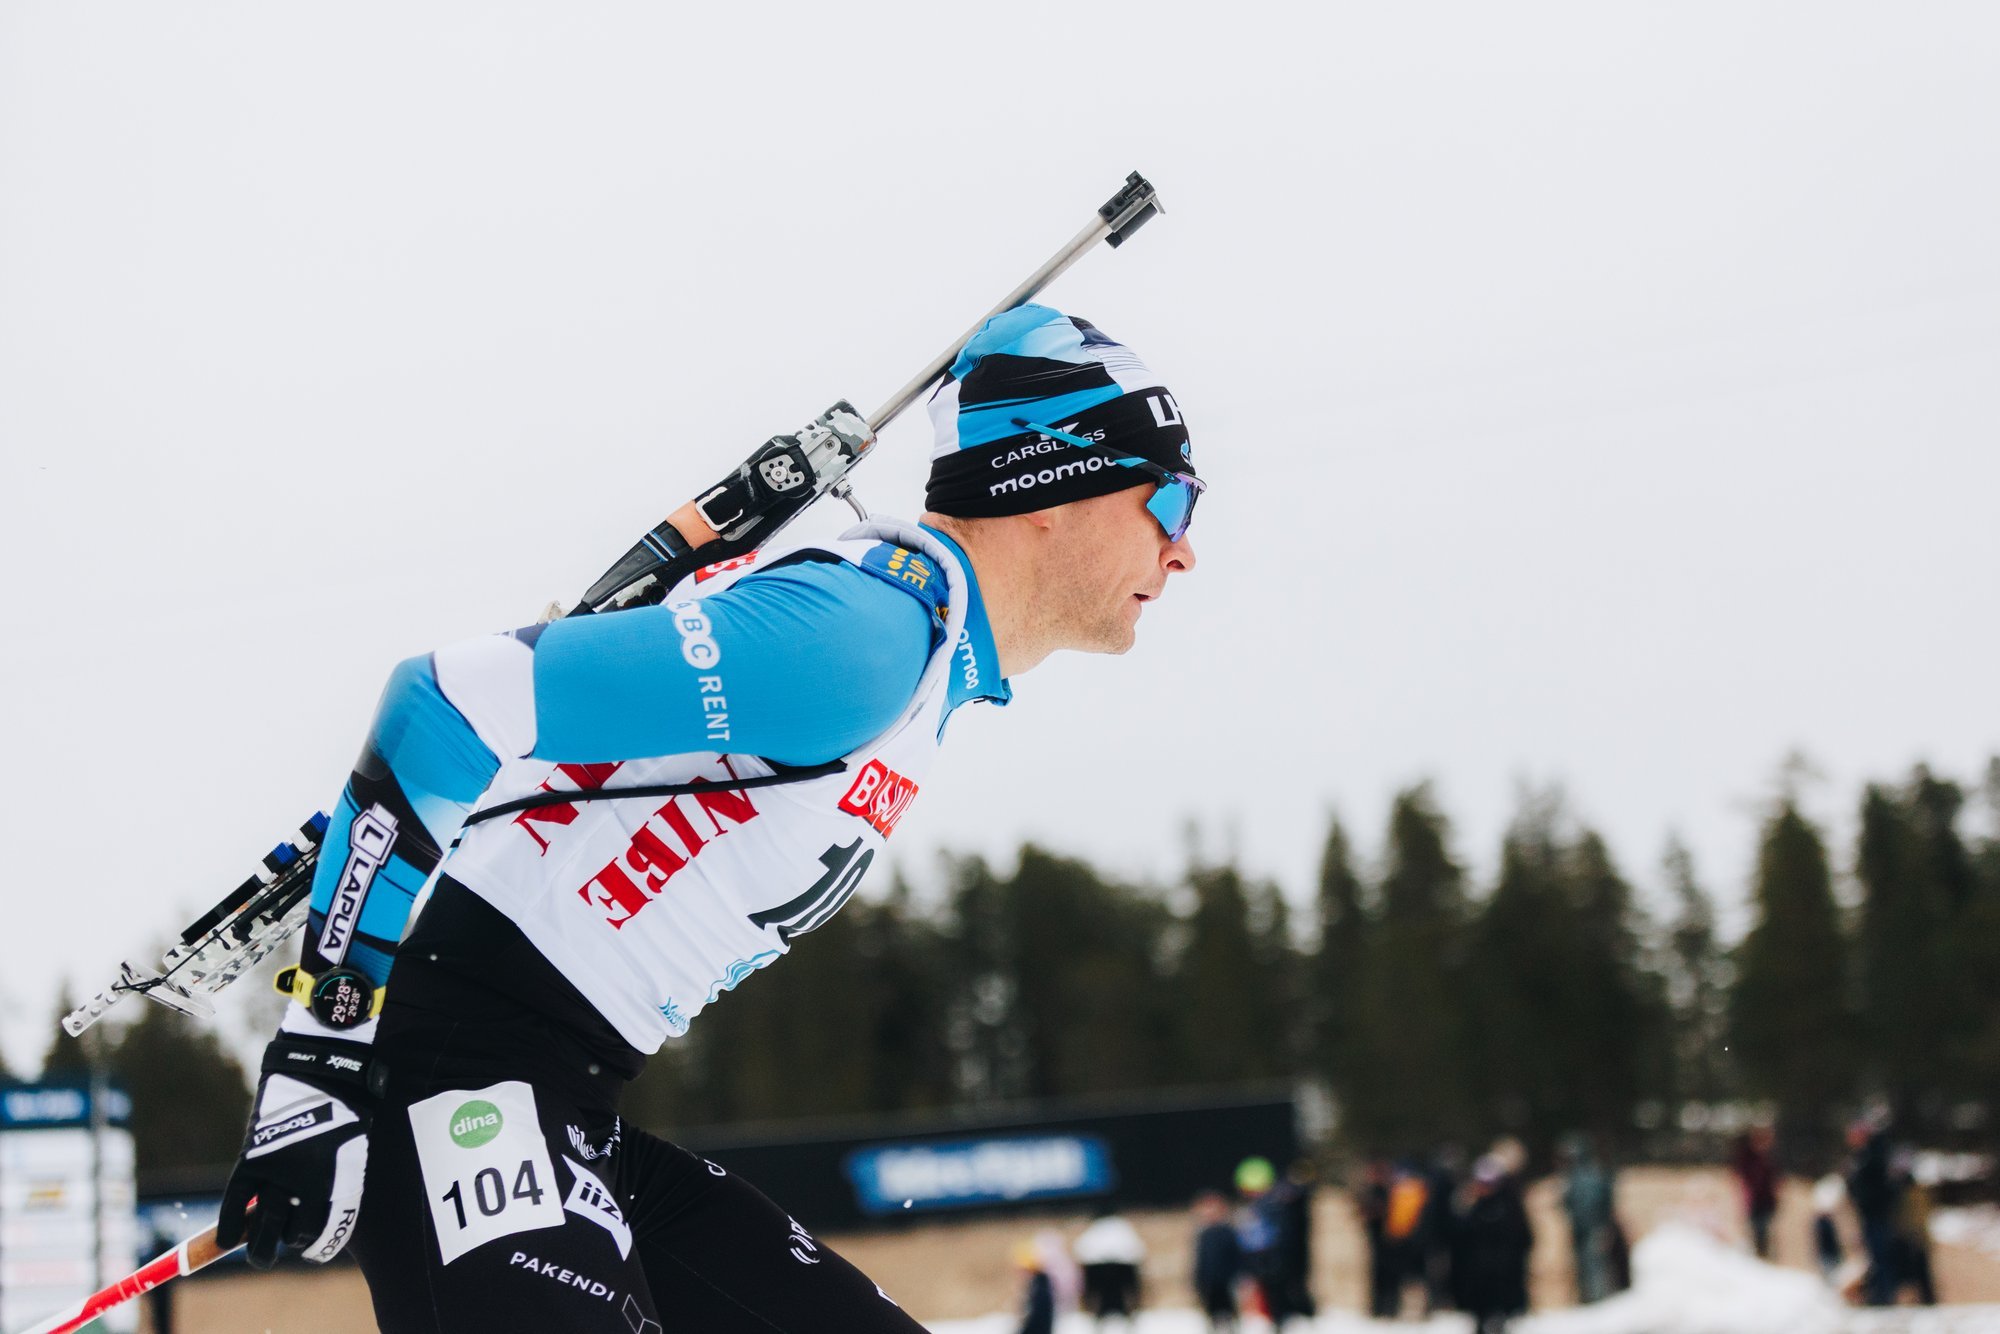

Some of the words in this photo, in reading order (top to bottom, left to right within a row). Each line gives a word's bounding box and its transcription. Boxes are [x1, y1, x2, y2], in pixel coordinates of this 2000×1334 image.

[991, 428, 1106, 469] CARGLSS
[698, 674, 731, 742] RENT
[578, 754, 760, 931] NIBE
[324, 859, 370, 952] LAPUA
[453, 1111, 498, 1136] dina
[442, 1159, 544, 1231] 104
[509, 1251, 616, 1302] PAKENDI
